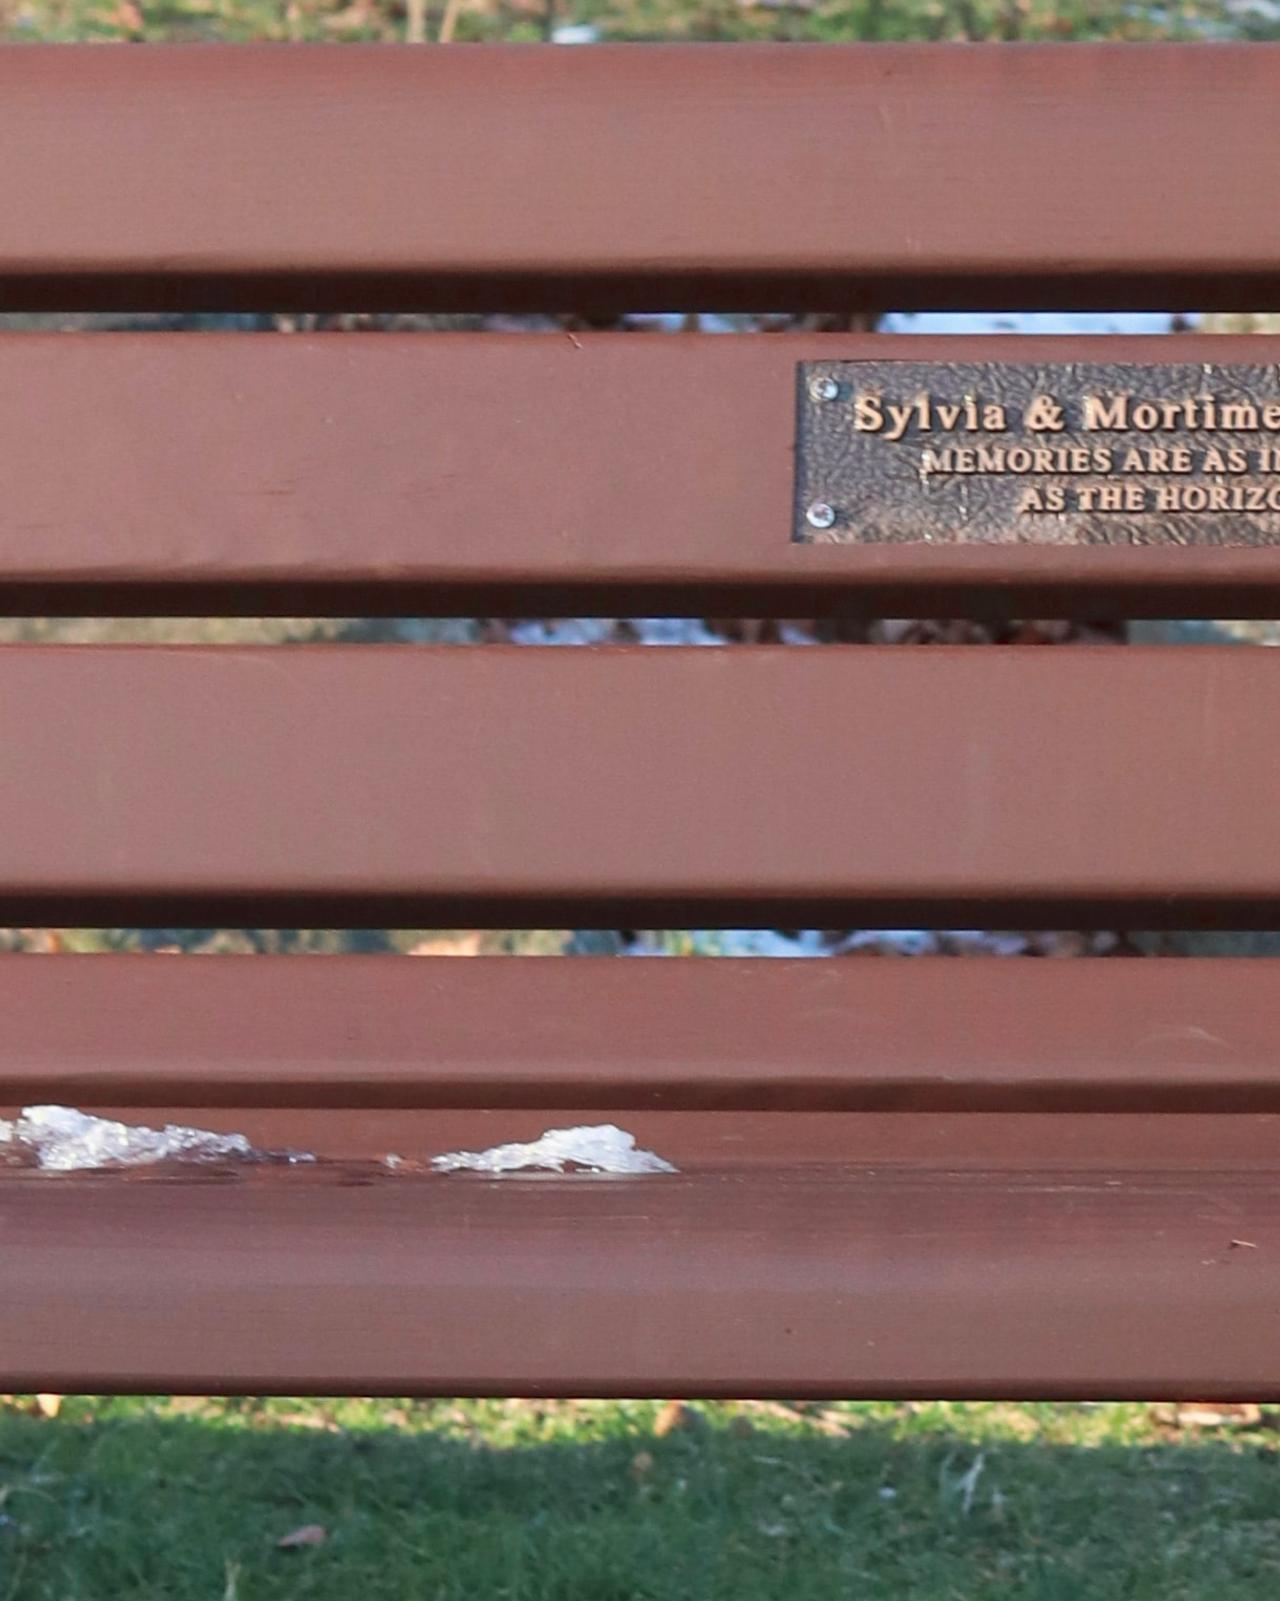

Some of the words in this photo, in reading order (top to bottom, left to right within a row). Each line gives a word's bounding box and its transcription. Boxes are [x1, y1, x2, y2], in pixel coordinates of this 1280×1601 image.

[855, 395, 1007, 441] Sylvia
[1024, 394, 1065, 431] &
[923, 448, 1113, 474] MEMORIES
[1122, 448, 1193, 474] ARE
[1202, 448, 1248, 474] AS
[1021, 486, 1065, 513] AS
[1077, 486, 1145, 513] THE
